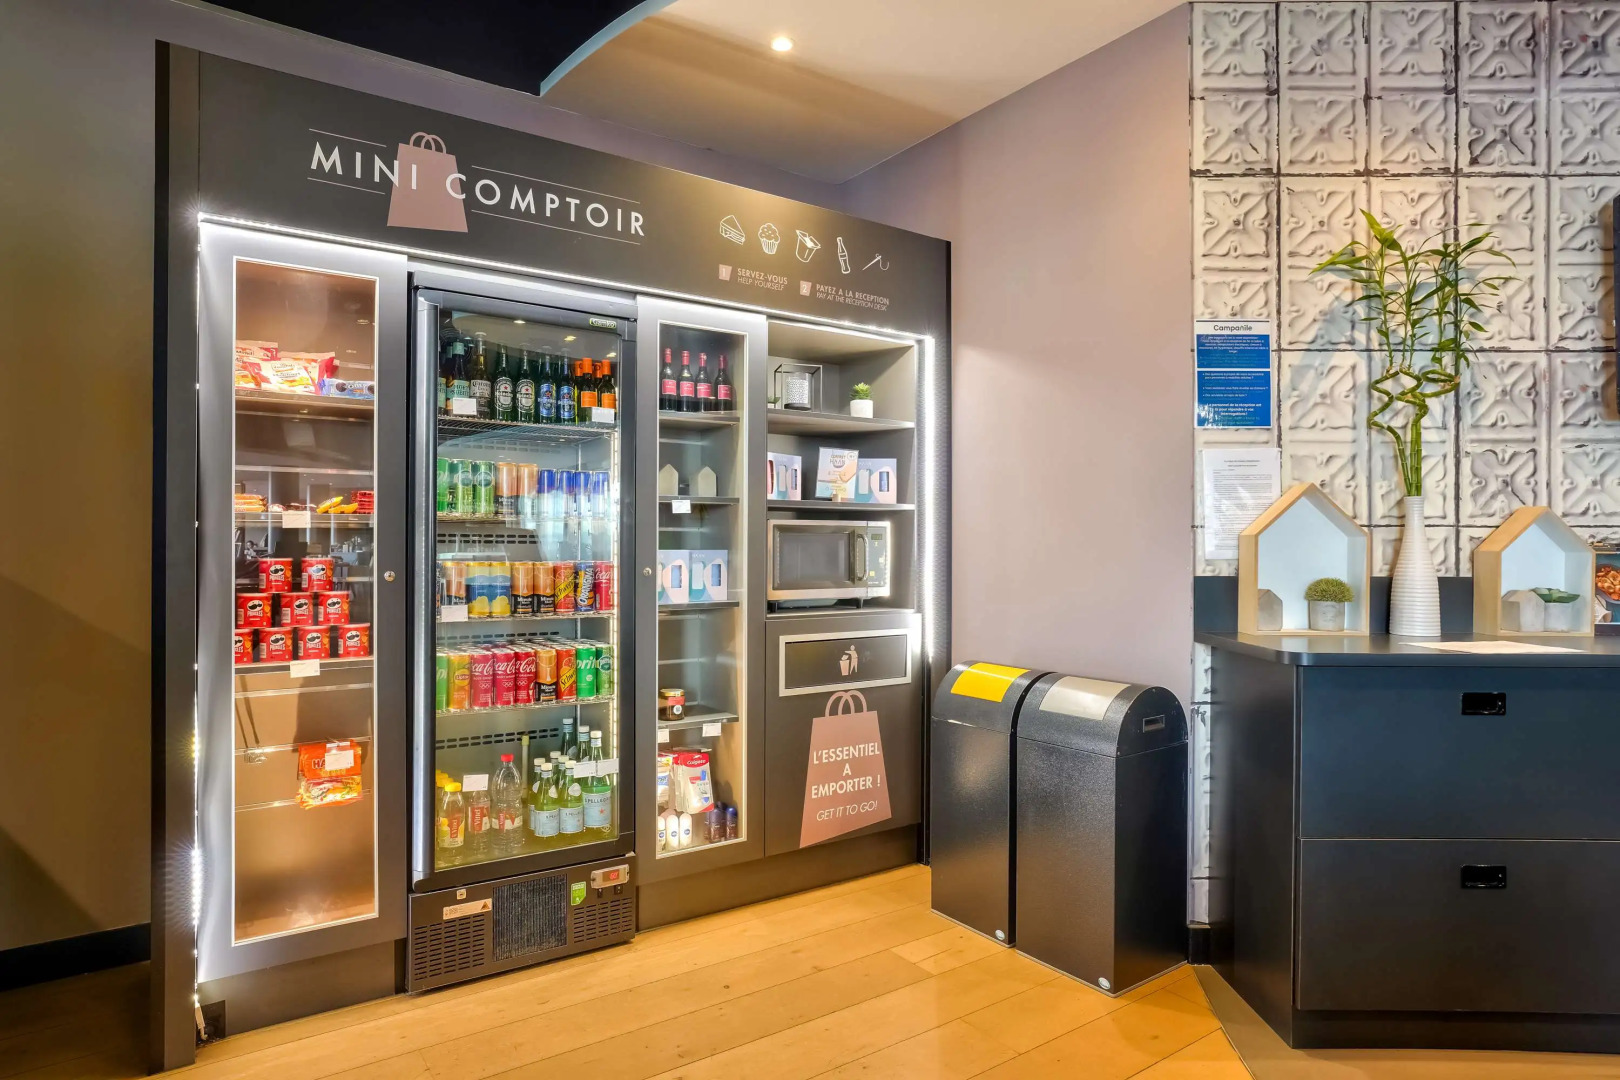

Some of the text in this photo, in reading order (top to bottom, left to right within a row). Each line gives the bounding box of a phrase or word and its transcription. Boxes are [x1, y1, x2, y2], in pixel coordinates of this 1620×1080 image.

[310, 141, 646, 236] MINI COMPTOIR
[721, 268, 727, 278] 1
[737, 267, 788, 285] SERVEZ-VOUS
[737, 276, 785, 291] HELP YOURSELF
[801, 283, 808, 293] 2
[816, 283, 890, 305] PAYEZ A LA RECEPTION
[816, 291, 826, 300] PAY
[835, 295, 845, 303] THE
[845, 297, 874, 309] RECEPTION
[873, 303, 888, 311] DESK
[1213, 324, 1253, 332] Campanile
[813, 742, 880, 764] L'ESSENTIEL
[842, 763, 852, 777] A
[811, 774, 881, 799] EMPORTER !
[816, 800, 878, 821] GET IT TO GO!
